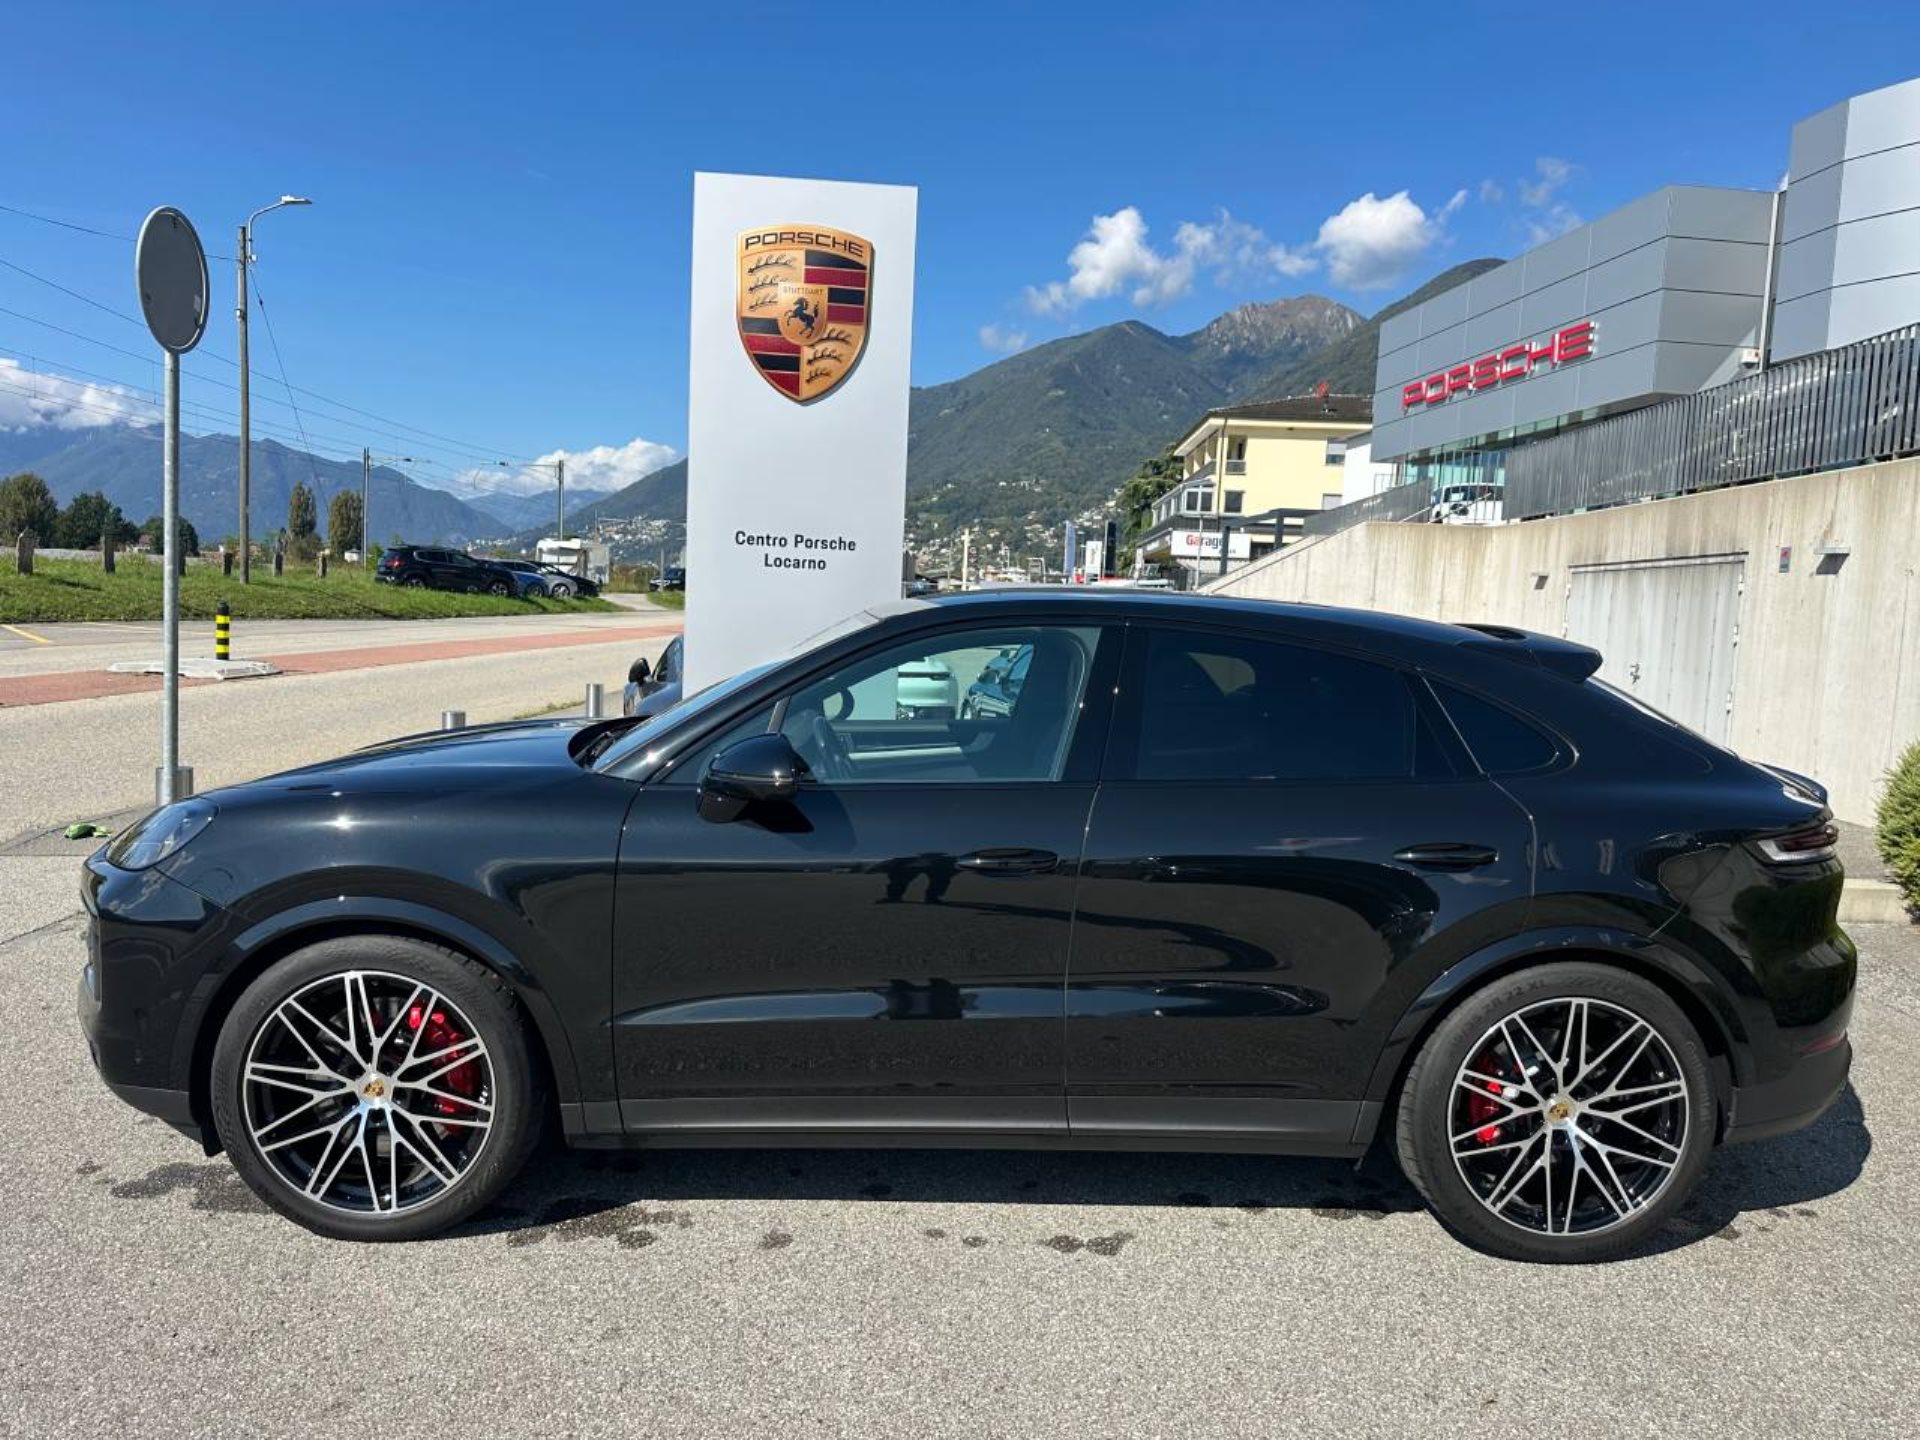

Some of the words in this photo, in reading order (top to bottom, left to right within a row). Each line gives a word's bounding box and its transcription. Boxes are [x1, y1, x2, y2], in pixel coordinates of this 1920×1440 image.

[745, 231, 864, 258] PORSCHE
[1402, 321, 1598, 411] PORSCHE
[735, 530, 788, 548] Centro
[794, 533, 856, 551] Porsche
[764, 552, 827, 570] Locarno
